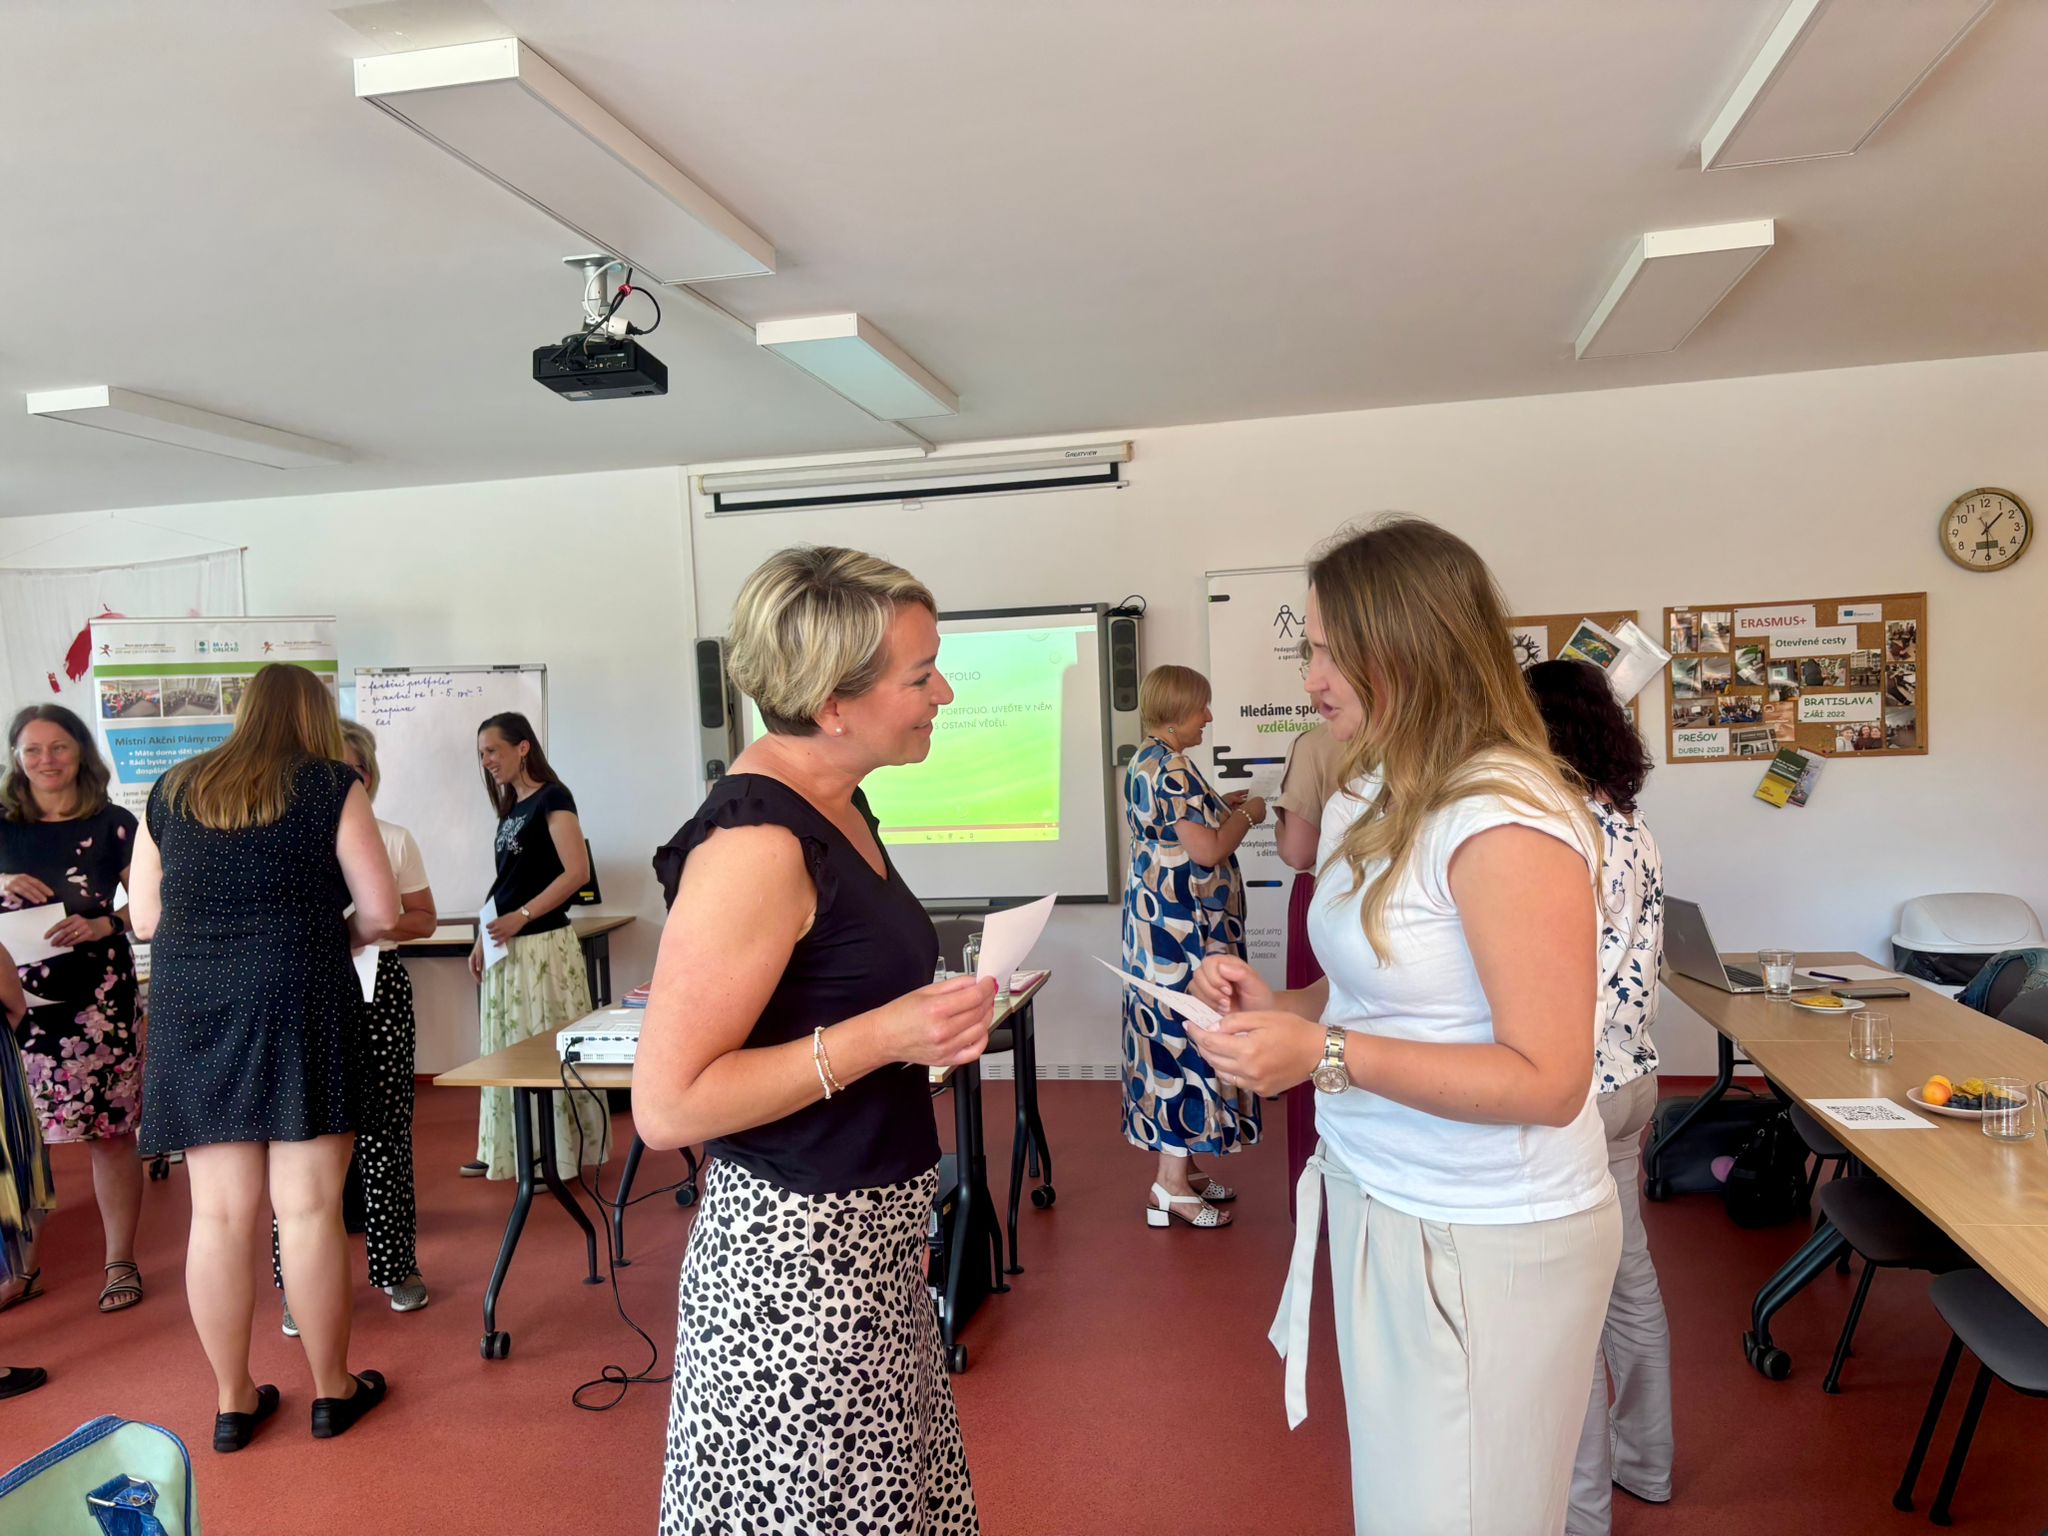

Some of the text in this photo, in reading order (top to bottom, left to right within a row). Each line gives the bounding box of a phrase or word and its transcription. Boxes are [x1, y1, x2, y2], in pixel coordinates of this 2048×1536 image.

[1980, 498, 1991, 508] 12
[1998, 501, 2002, 510] 1
[1966, 504, 1975, 514] 11
[2008, 509, 2015, 519] 2
[1957, 514, 1968, 524] 10
[2014, 522, 2021, 532] 3
[1952, 528, 1959, 538] 9
[1958, 541, 1965, 550] 8
[2009, 536, 2017, 545] 4
[1970, 549, 1977, 559] 7
[1999, 547, 2006, 556] 5
[1741, 615, 1807, 629] ERASMUS+
[1775, 637, 1847, 648] Otevřené cesty
[1804, 697, 1873, 706] BRATISLAVA
[1240, 703, 1292, 717] Hledáme
[1804, 710, 1824, 718] ZÁŘÍ
[941, 720, 977, 730] OSTATNÍ
[115, 736, 146, 747] Místní
[148, 735, 176, 746] Akční
[178, 735, 205, 745] Plány
[1678, 732, 1718, 742] PREŠOV
[155, 749, 177, 757] doma
